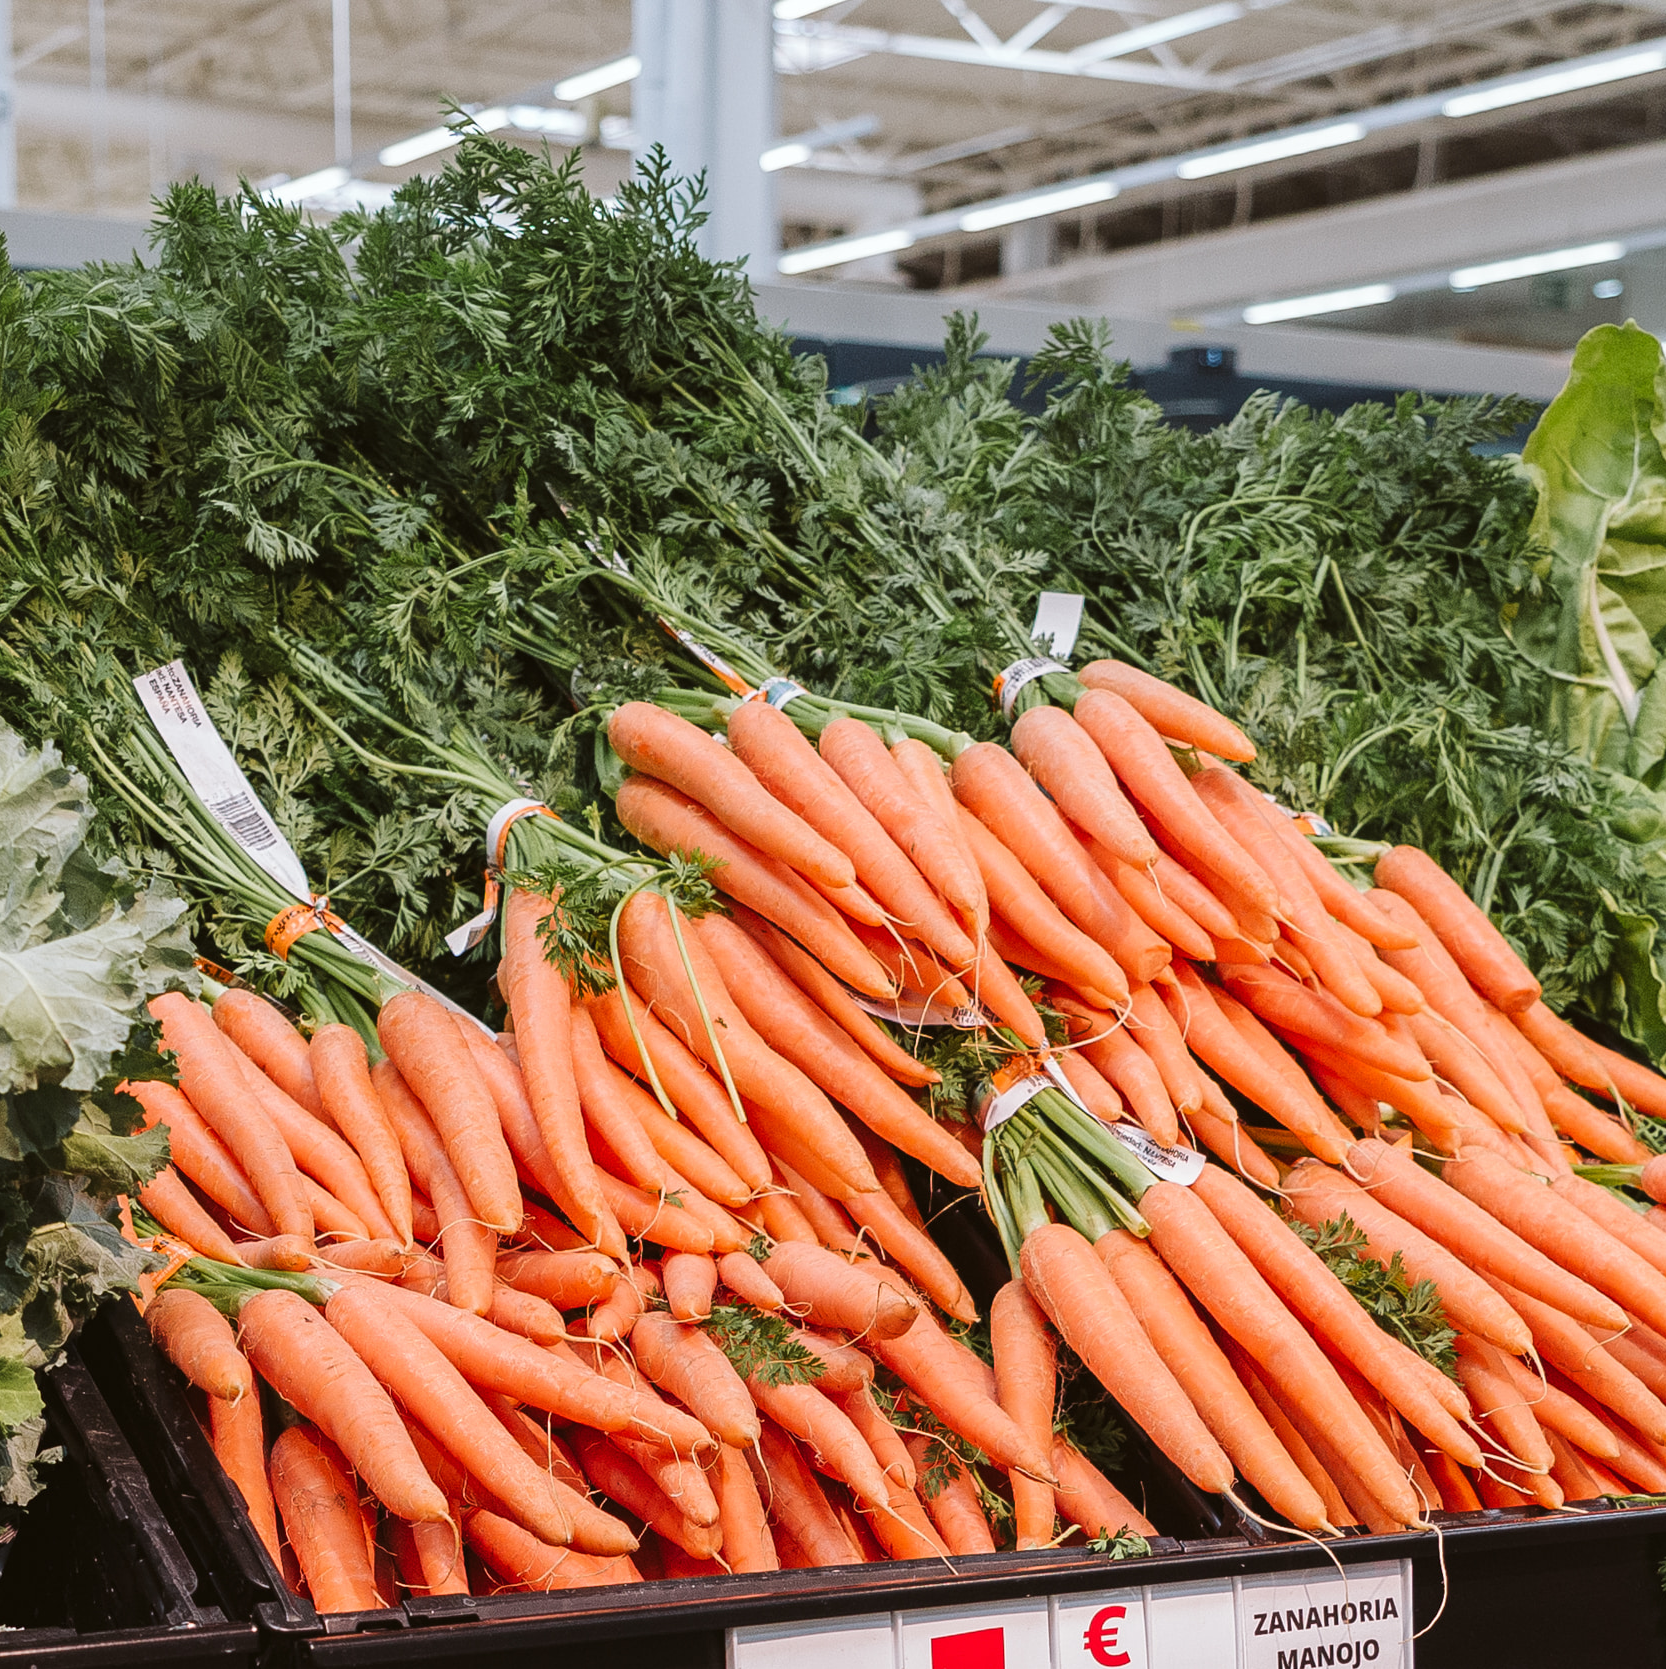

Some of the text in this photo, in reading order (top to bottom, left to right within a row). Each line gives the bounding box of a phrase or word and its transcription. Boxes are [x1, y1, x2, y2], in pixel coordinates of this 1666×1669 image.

[149, 679, 171, 715] ESPAÑA
[163, 682, 187, 724] NANTESA
[1083, 1606, 1131, 1667] €
[1254, 1597, 1398, 1636] ZANAHORIA
